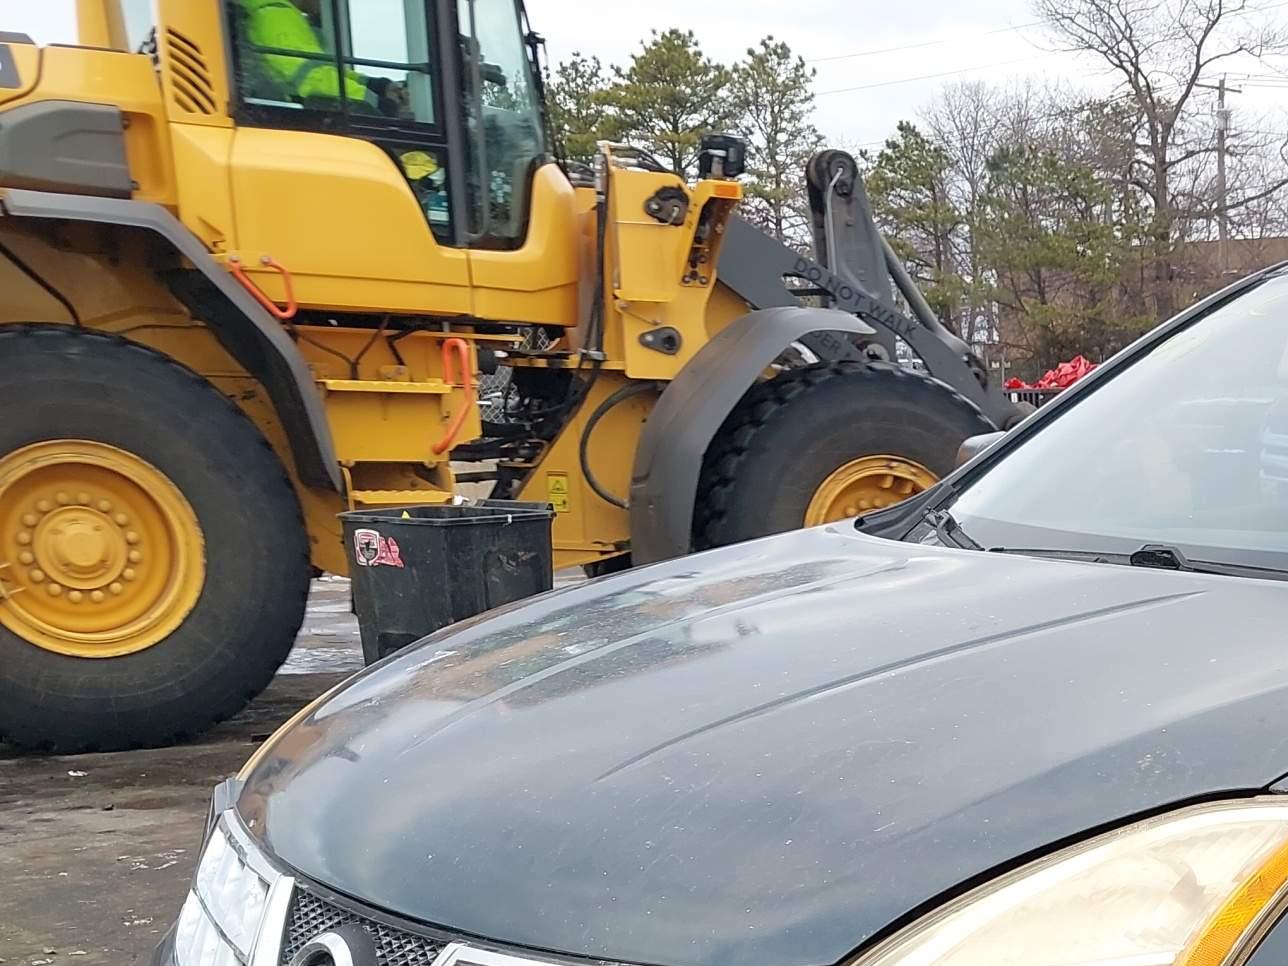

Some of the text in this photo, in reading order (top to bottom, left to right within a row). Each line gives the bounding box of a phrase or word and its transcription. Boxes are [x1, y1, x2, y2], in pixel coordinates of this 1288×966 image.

[794, 260, 917, 338] DO NOT WALK
